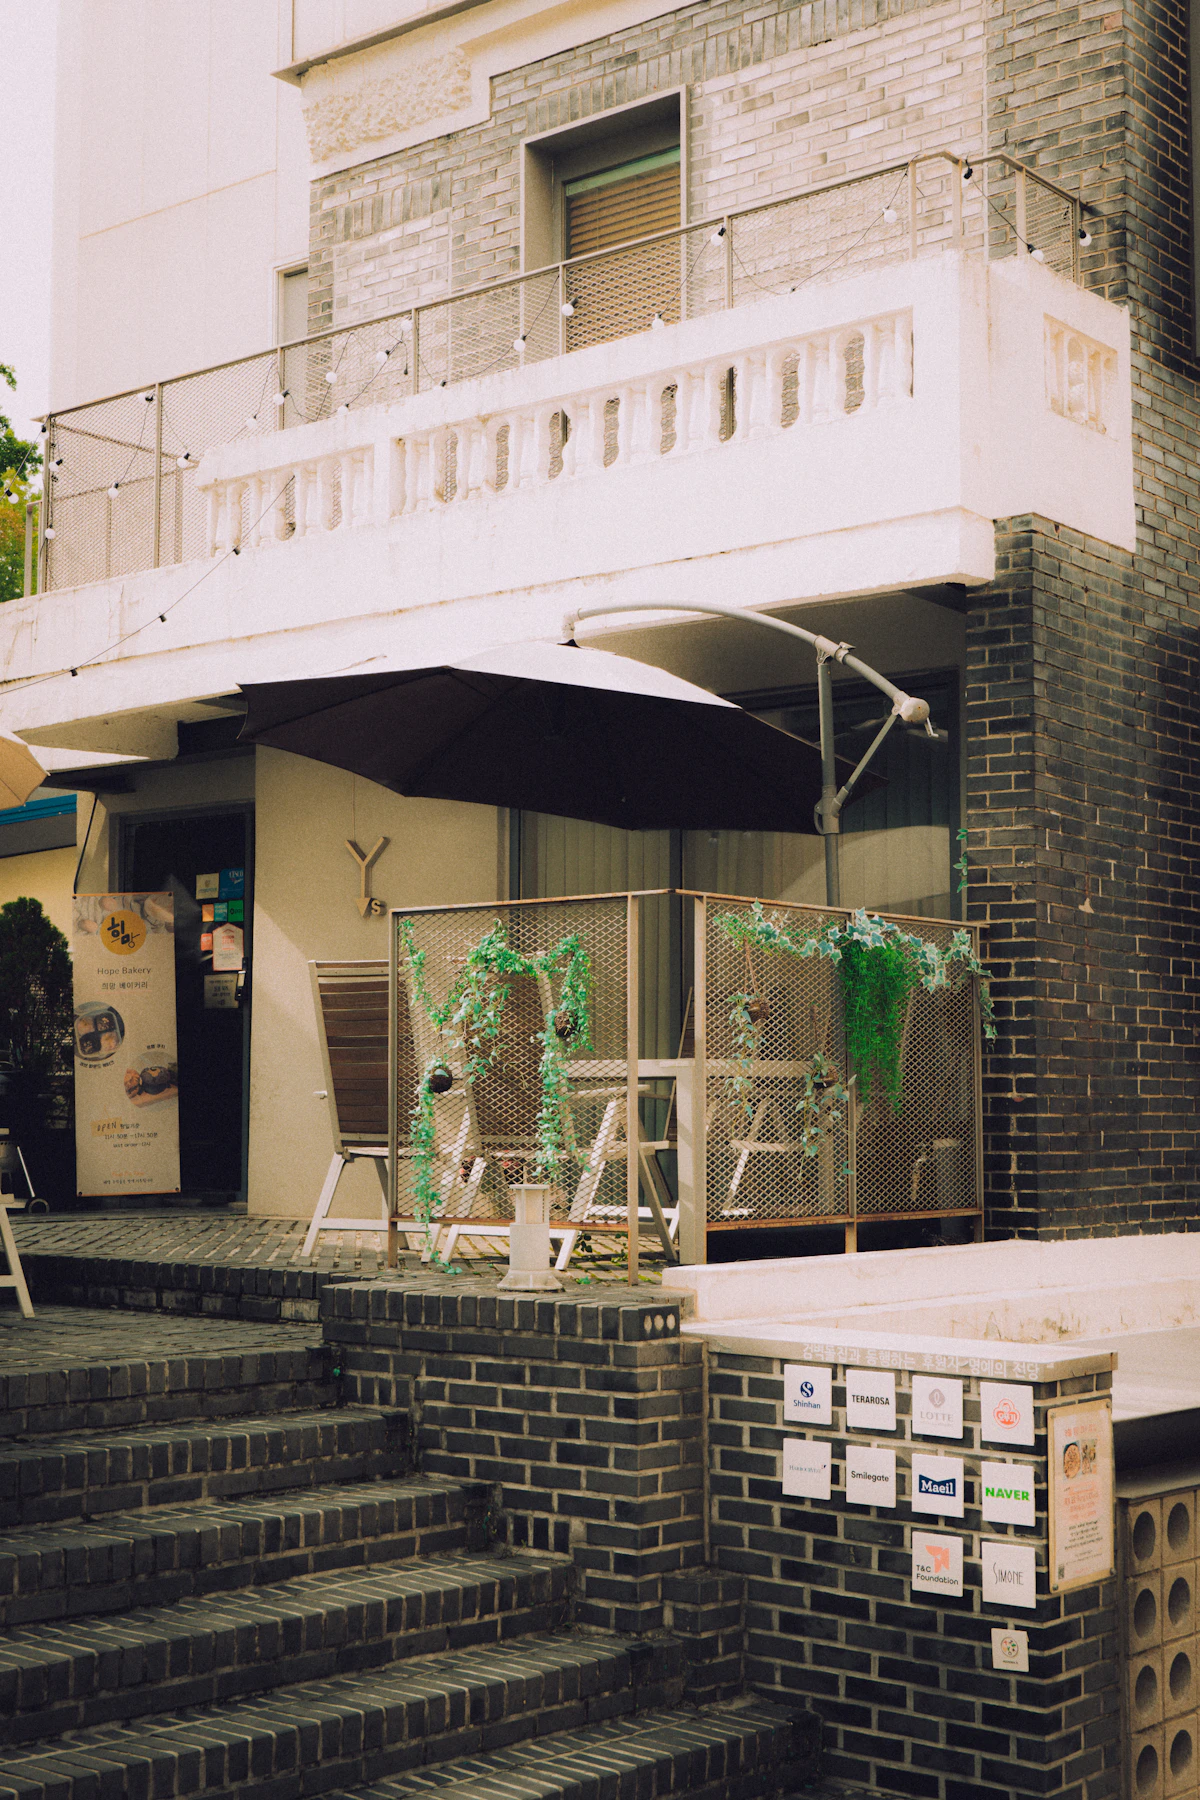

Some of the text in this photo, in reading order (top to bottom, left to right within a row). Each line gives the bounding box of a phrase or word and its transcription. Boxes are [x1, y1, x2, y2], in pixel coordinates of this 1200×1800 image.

[97, 967, 152, 976] Hope Bakery
[101, 981, 148, 990] 희망 베이커리
[97, 1121, 117, 1132] OPEN
[803, 1343, 1040, 1381] 검벽돌집과 동행하는 후원자 명예의 전당
[793, 1399, 821, 1410] Shinhan
[851, 1394, 890, 1406] TERAROSA
[920, 1410, 954, 1422] LOTTE
[851, 1470, 890, 1483] Smilegate
[921, 1479, 954, 1495] Maeil
[985, 1486, 1030, 1501] NAVER
[916, 1564, 931, 1573] T&C
[992, 1562, 1024, 1585] SIMONE
[916, 1573, 959, 1586] Foundation
